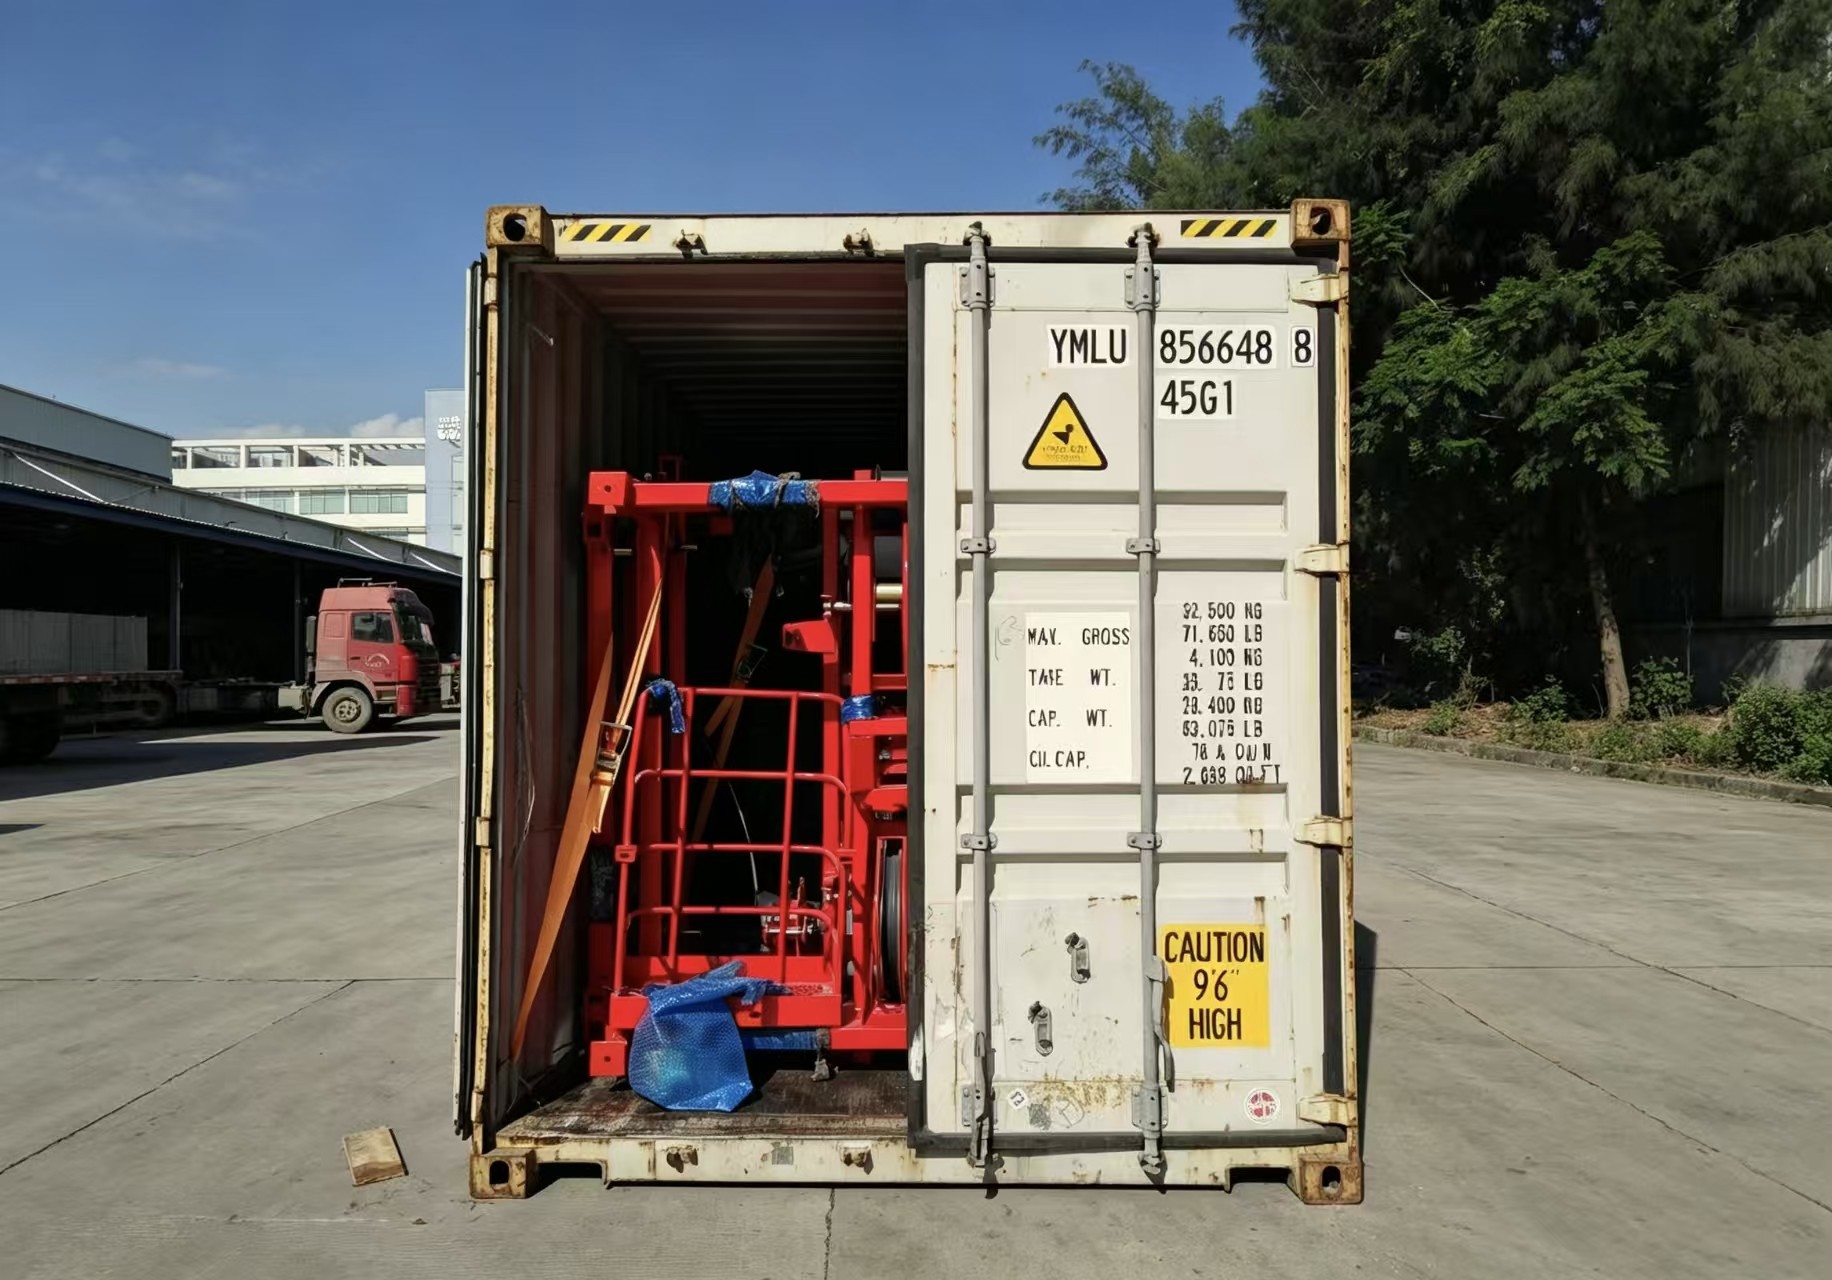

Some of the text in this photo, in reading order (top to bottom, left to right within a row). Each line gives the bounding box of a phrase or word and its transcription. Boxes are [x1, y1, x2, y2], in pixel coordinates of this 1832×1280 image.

[1051, 328, 1312, 365] YMLU 856648 8
[1160, 379, 1233, 415] 45G1
[1082, 627, 1130, 646] GROSS
[1090, 668, 1117, 687] WT.
[1028, 708, 1113, 728] CAP. WT.
[1244, 719, 1263, 738] LB
[1164, 931, 1264, 963] CAUTION
[1189, 1008, 1241, 1040] HIGH
